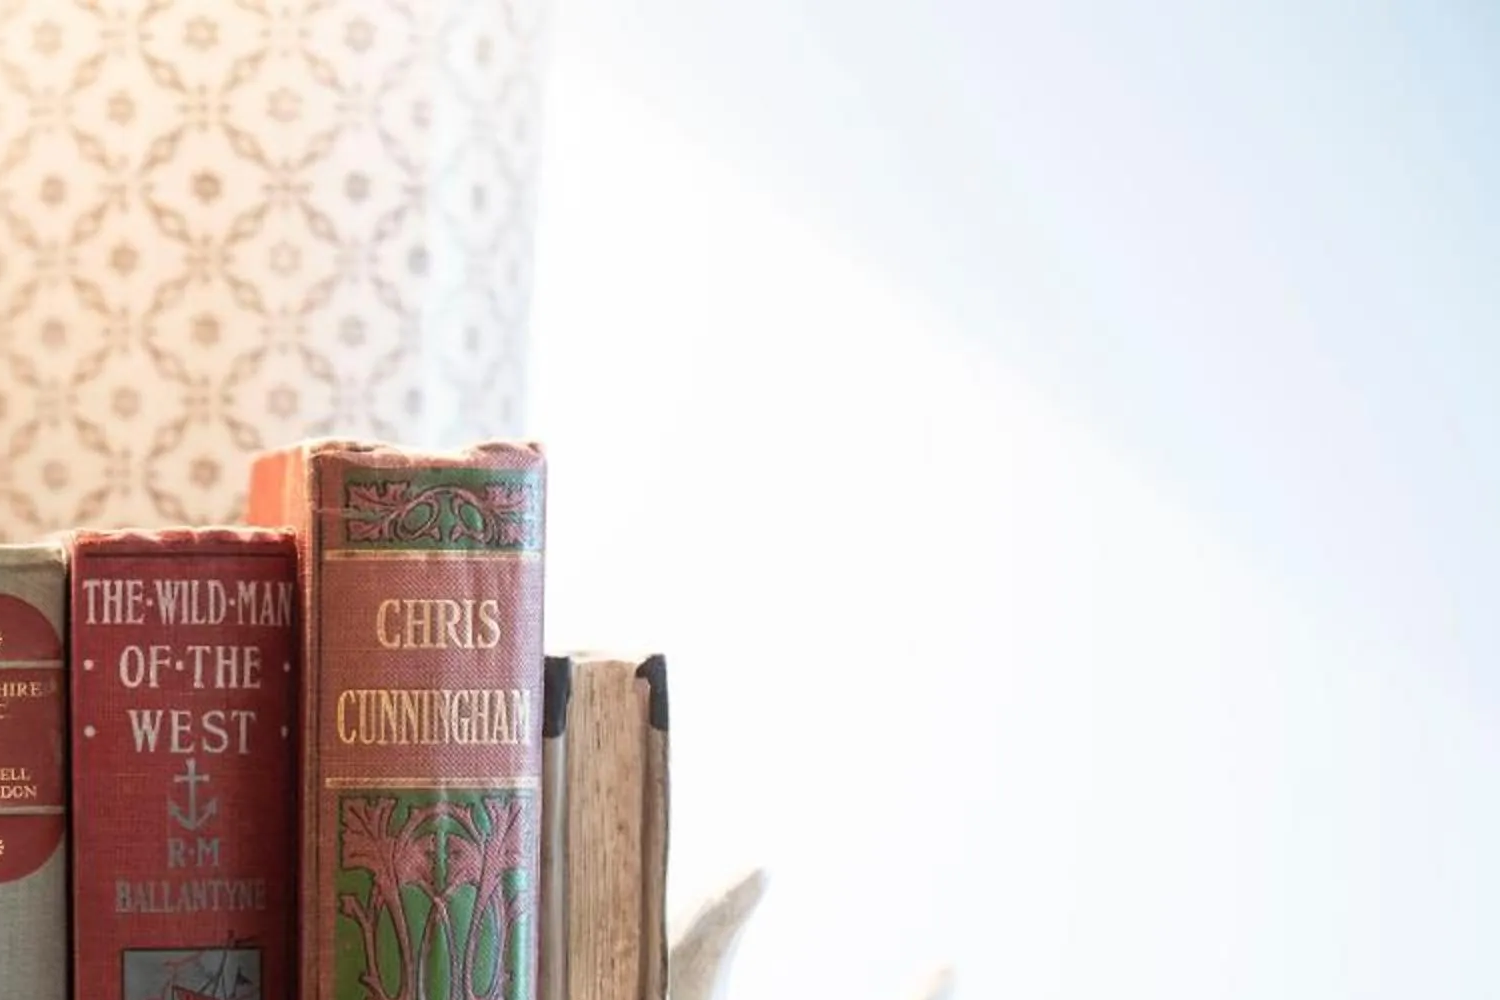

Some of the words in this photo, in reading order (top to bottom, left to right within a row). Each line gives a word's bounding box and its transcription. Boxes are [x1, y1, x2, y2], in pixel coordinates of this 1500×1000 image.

[83, 578, 146, 624] THE
[154, 578, 226, 625] WILD
[376, 598, 501, 649] CHRIS
[119, 645, 171, 688] OF
[186, 645, 262, 689] THE
[127, 709, 256, 754] WEST
[337, 688, 531, 745] CUNNINGHAM
[114, 878, 266, 914] BALLANTYNE
